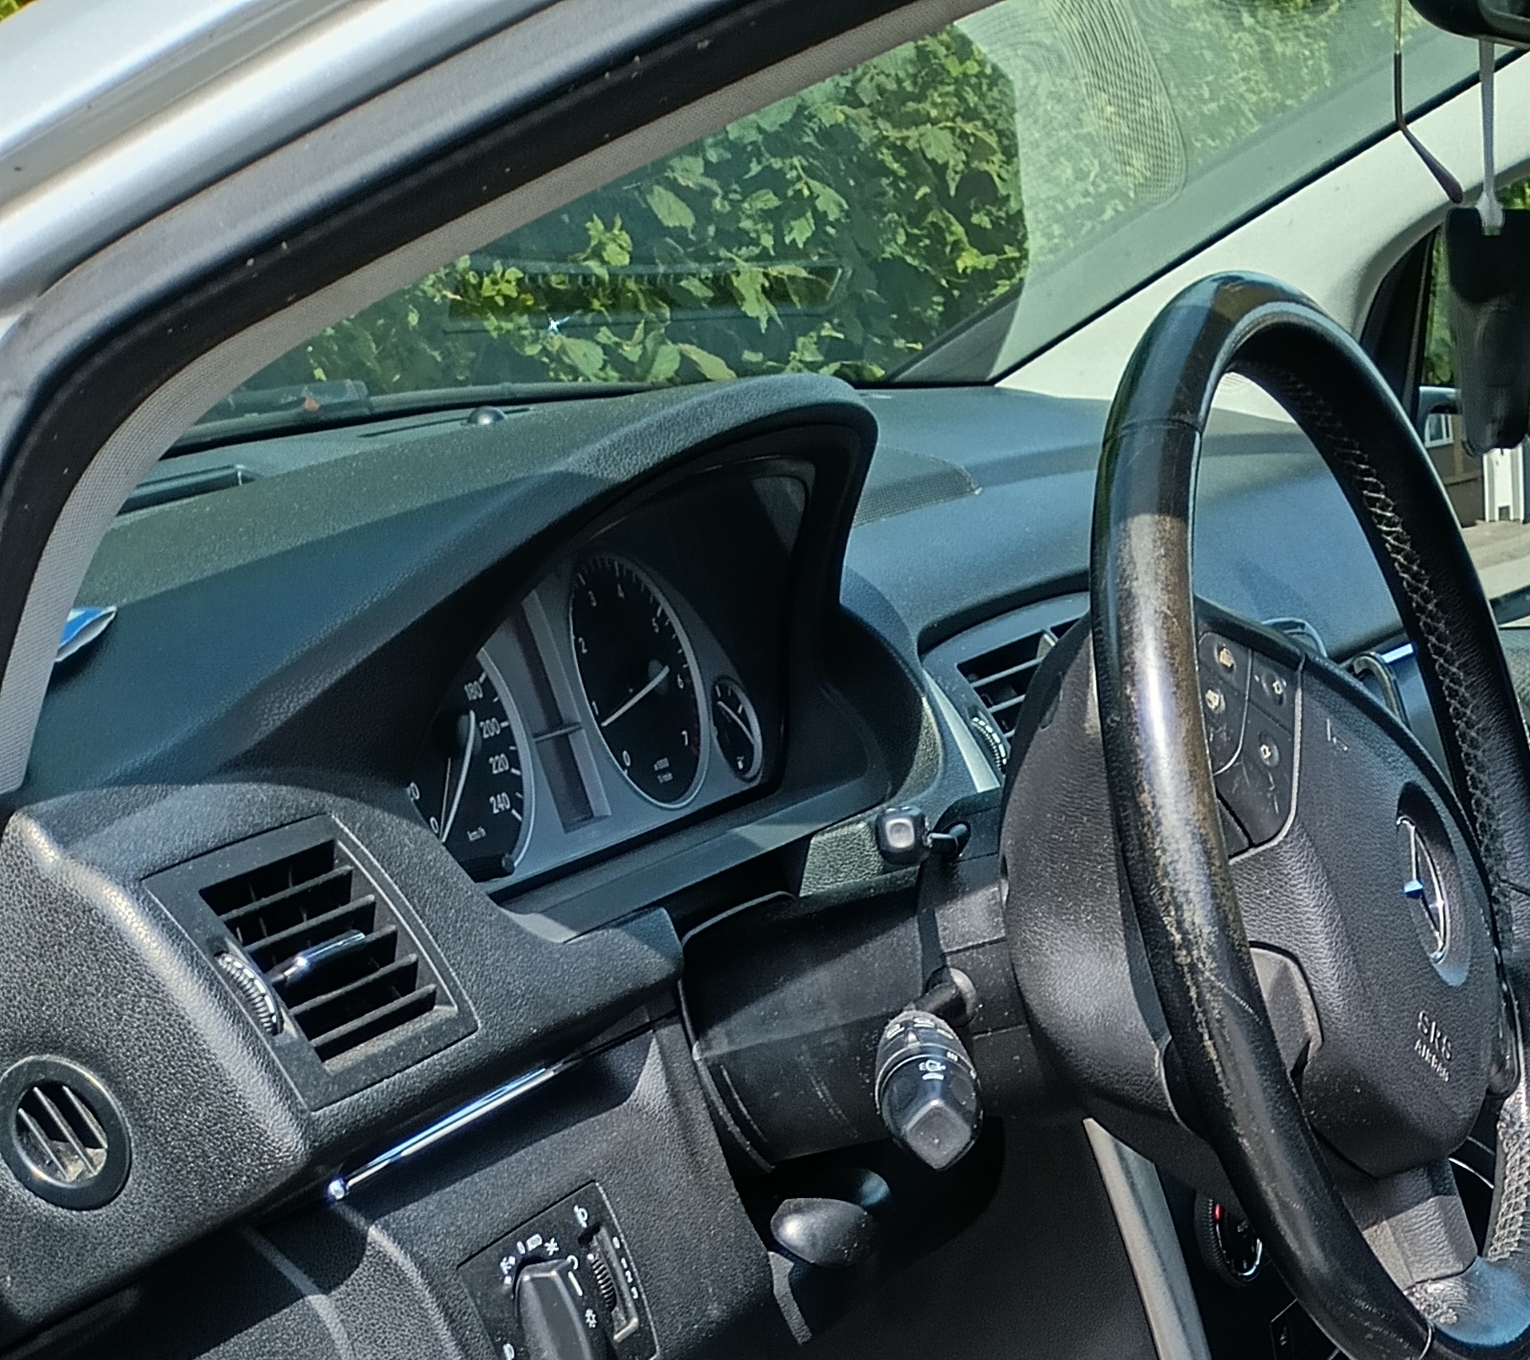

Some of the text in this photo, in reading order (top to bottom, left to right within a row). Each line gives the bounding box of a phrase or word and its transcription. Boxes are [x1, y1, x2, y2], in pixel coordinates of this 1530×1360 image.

[578, 637, 588, 654] 2
[464, 681, 484, 700] 180
[479, 717, 500, 739] 200
[680, 730, 689, 746] 7
[489, 753, 510, 775] 220
[622, 750, 631, 767] 0
[489, 792, 511, 815] 240
[429, 816, 439, 834] 0
[1417, 1010, 1452, 1062] SRS
[625, 1270, 633, 1283] 2
